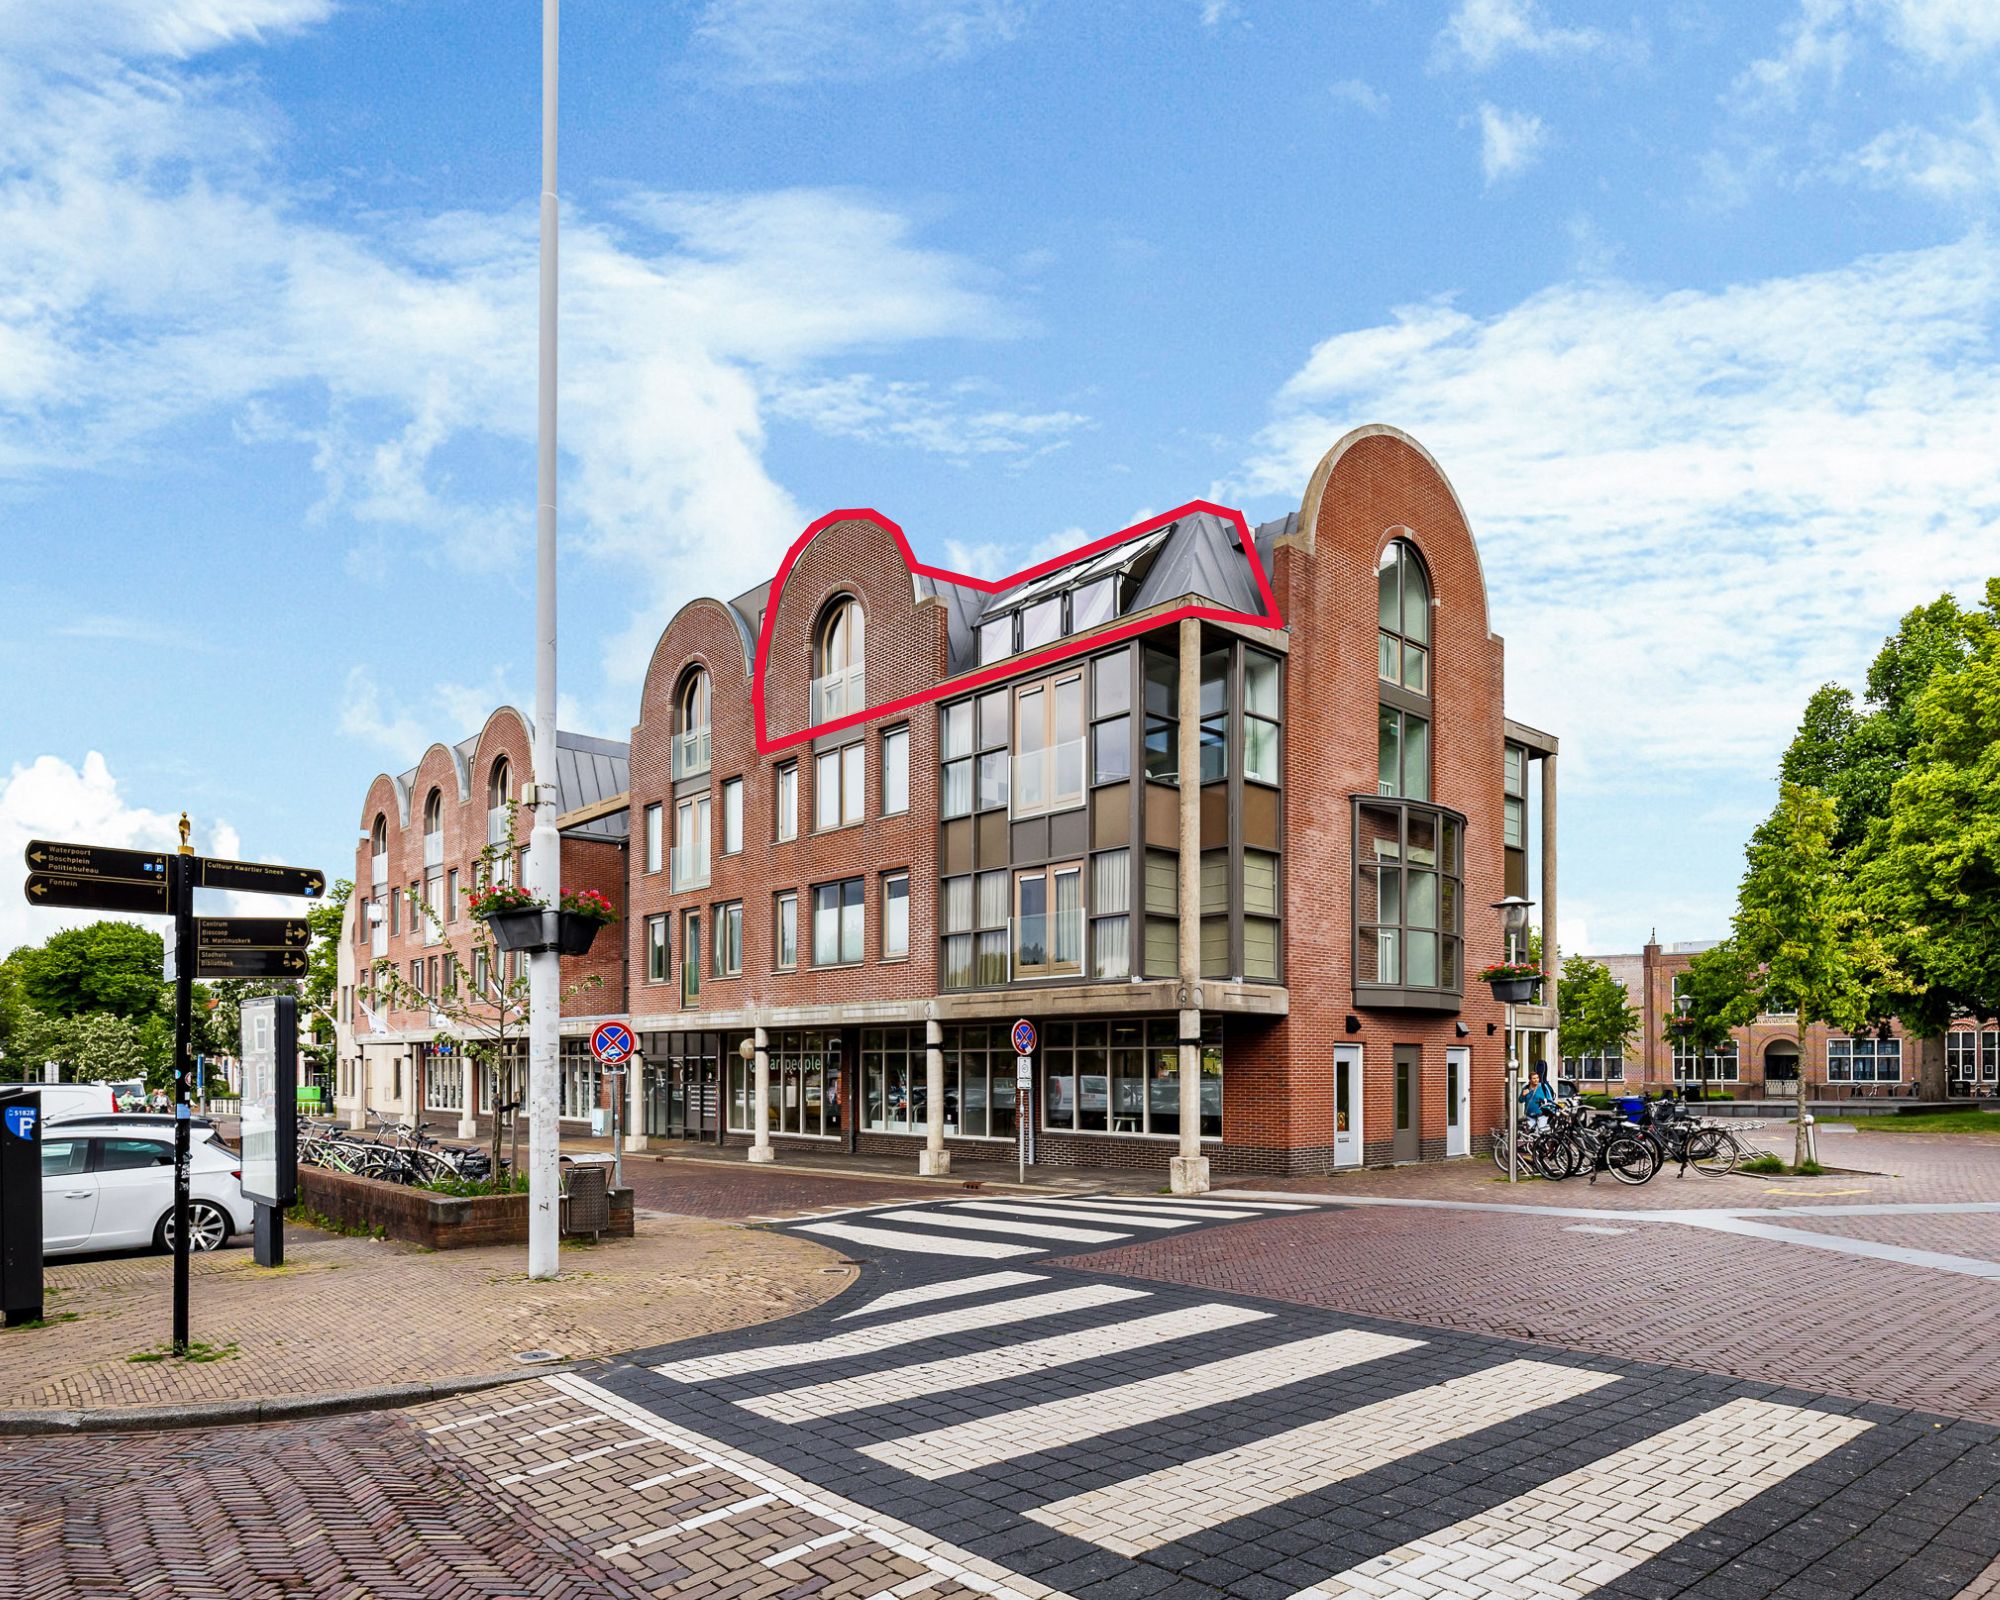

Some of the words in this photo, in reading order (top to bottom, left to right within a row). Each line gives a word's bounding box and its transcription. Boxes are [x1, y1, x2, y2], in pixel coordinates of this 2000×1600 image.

[48, 846, 91, 856] Waterpoort
[48, 855, 90, 865] Boschplein
[48, 863, 99, 874] Politiebureau
[207, 861, 233, 871] Cultuur
[235, 865, 263, 873] Kwartier
[49, 879, 78, 887] Fontein
[20, 1117, 35, 1136] P
